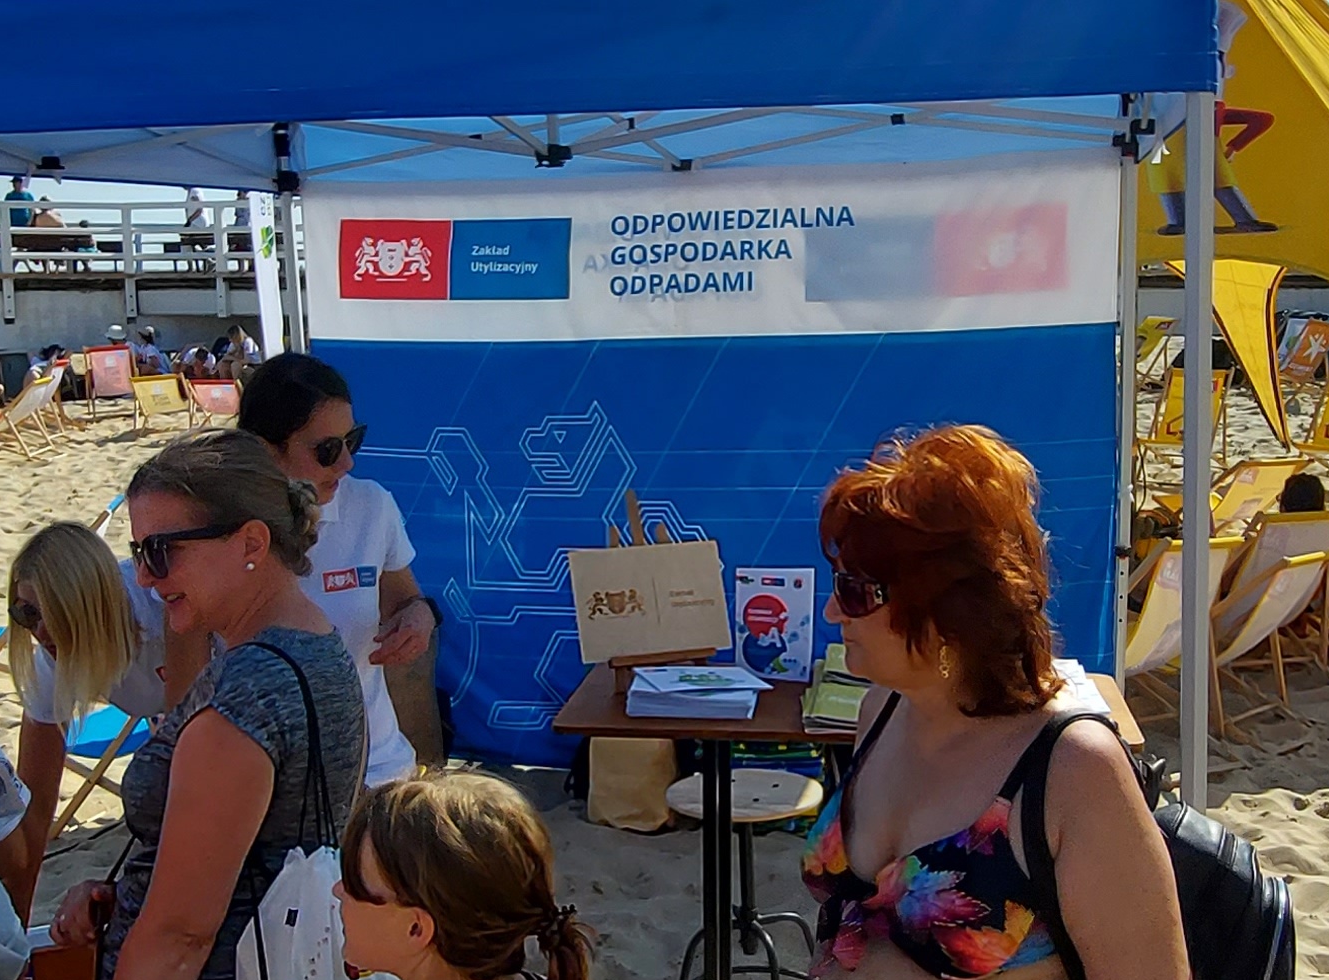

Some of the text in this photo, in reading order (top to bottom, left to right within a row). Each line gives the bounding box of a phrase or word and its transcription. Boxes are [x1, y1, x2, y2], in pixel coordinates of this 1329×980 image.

[610, 206, 856, 237] ODPOWIEDZIALNA
[471, 244, 510, 257] Zakład
[609, 239, 793, 266] GOSPODARKA
[470, 261, 538, 275] Utylizacyjny
[609, 271, 754, 297] ODPADAMI
